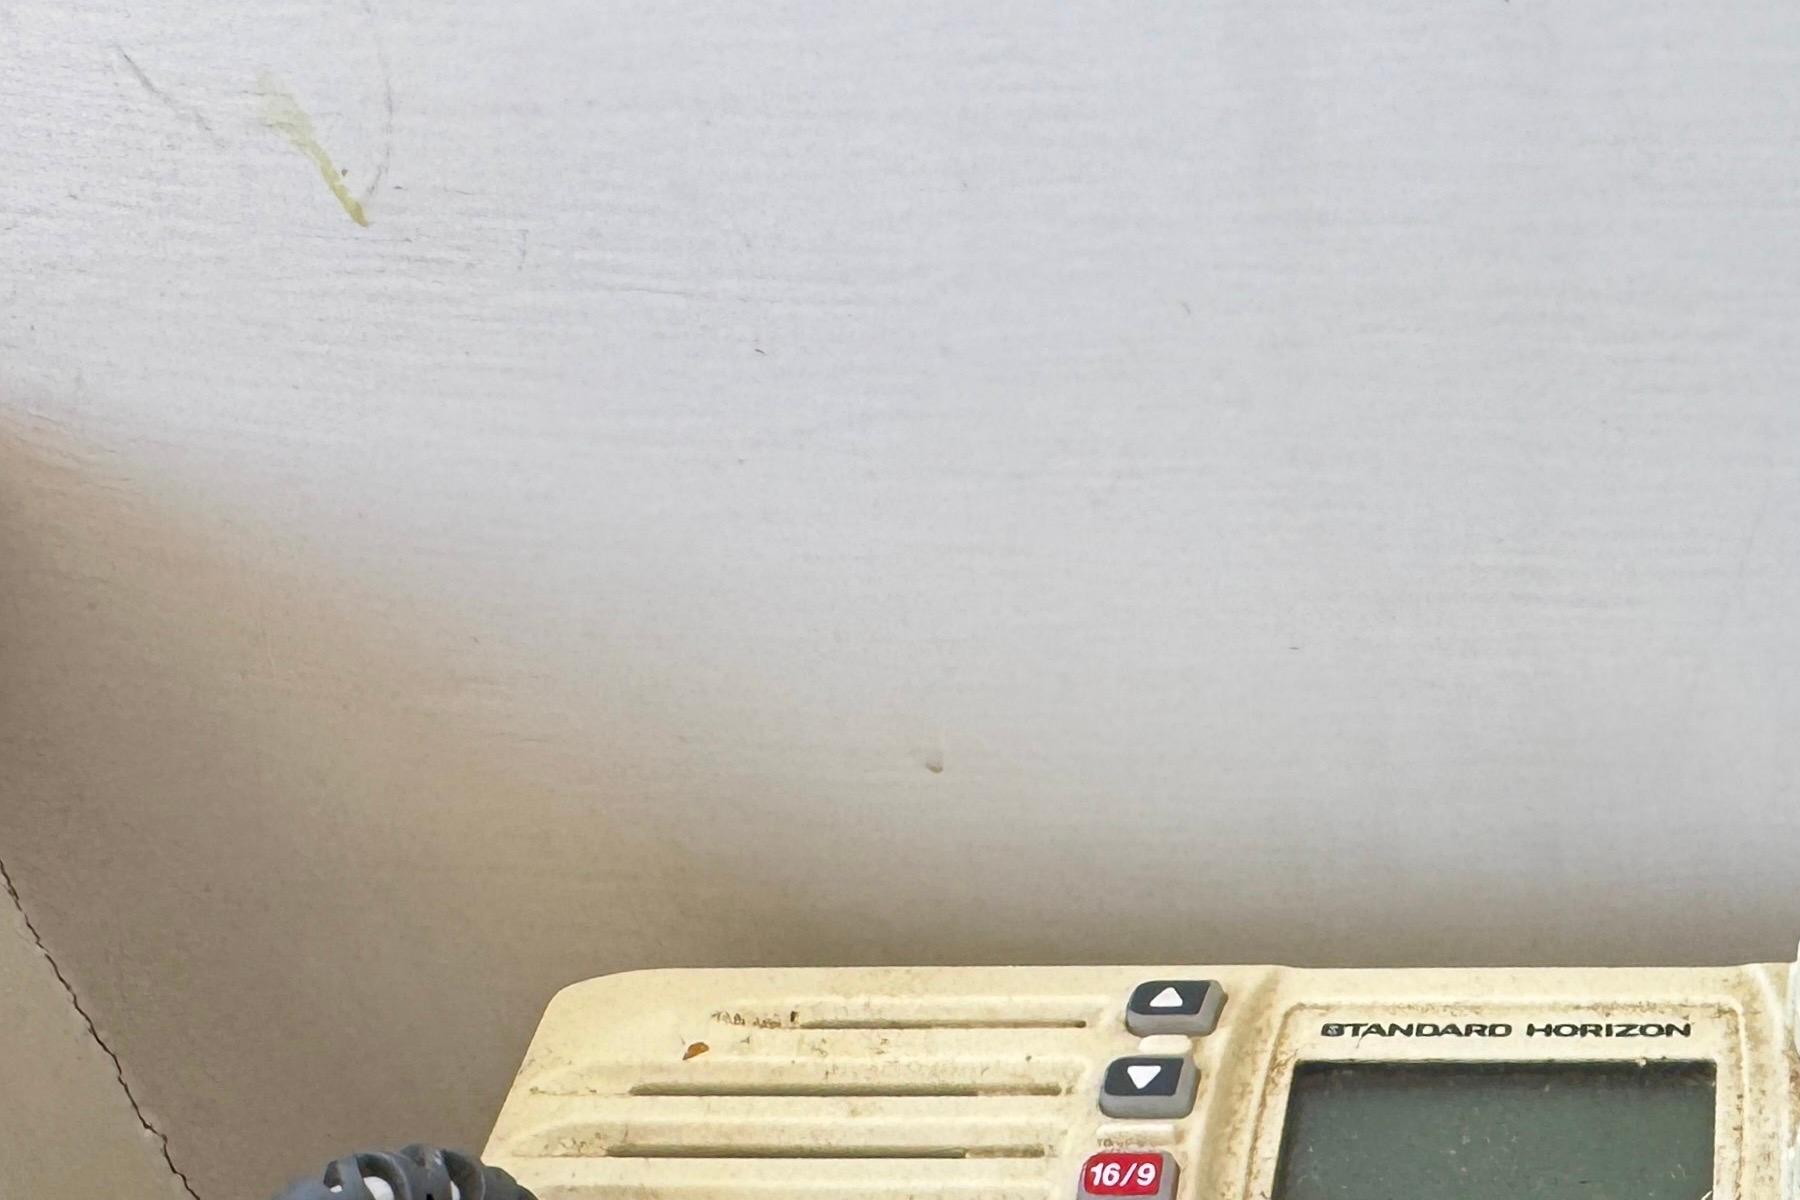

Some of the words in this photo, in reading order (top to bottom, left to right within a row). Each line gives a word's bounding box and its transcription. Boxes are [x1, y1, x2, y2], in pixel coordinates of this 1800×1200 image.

[1321, 1022, 1513, 1038] STANDARD
[1526, 1022, 1693, 1038] HORIZON
[1090, 1161, 1157, 1187] 16/9
